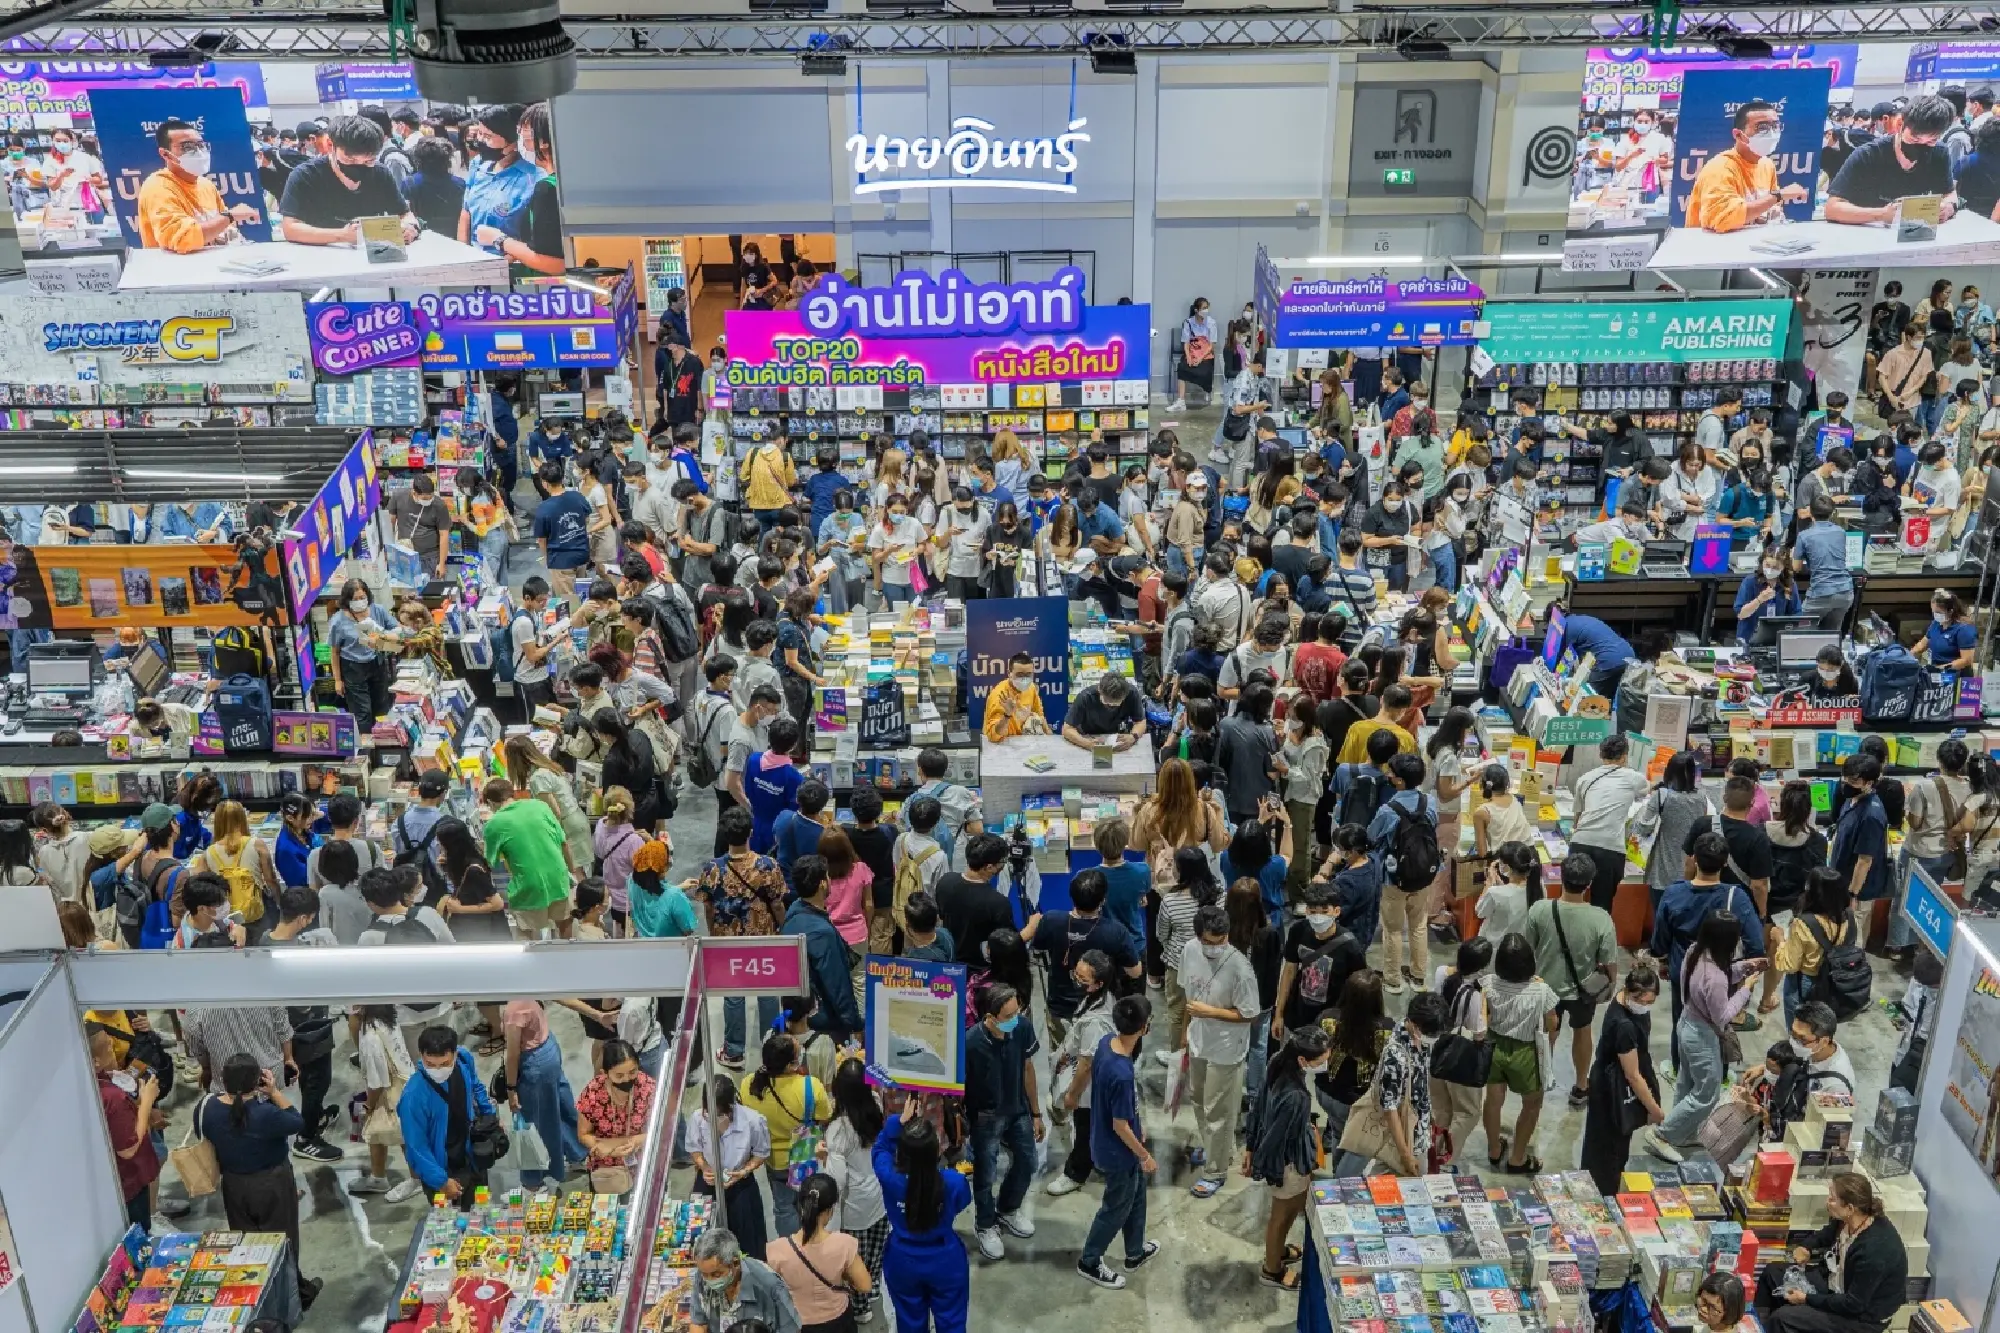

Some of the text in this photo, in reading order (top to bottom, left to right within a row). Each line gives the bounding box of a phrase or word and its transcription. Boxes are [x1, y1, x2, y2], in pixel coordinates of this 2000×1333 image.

[0, 81, 47, 97] OP20
[1621, 76, 1682, 94] ติดชาร์
[26, 94, 91, 113] ติดชาร์
[846, 116, 1090, 175] นายอินทร์
[1374, 150, 1398, 160] EXIT
[1375, 242, 1389, 251] LG
[1815, 271, 1872, 279] START
[1292, 279, 1467, 298] นายอินทร์หาให้ จุดชำระเงิน
[421, 287, 593, 326] จุดชำระเงิน
[808, 273, 1074, 329] อ่านไม่เอาท์
[1284, 301, 1386, 313] และออกใบกำกับภาษี
[318, 304, 402, 343] Cute
[1664, 314, 1776, 334] AMARIN
[1819, 302, 1862, 349] 3
[43, 316, 235, 362] SHONEN GT
[1661, 333, 1773, 350] PUBLISHING
[122, 344, 160, 363] 少年
[324, 330, 415, 369] CORNER
[775, 340, 858, 361] TOP20
[978, 341, 1119, 381] หนังสือใหม่
[728, 357, 923, 385] อันดับฮิต ติดชาร์ต
[1814, 694, 1861, 708] howto
[1552, 720, 1583, 730] BEST
[1770, 711, 1784, 721] THE
[1787, 711, 1798, 721] NO
[1801, 711, 1836, 721] ASSHOLE
[1551, 731, 1603, 742] SELLERS
[1918, 896, 1941, 935] F44
[729, 957, 776, 976] F45
